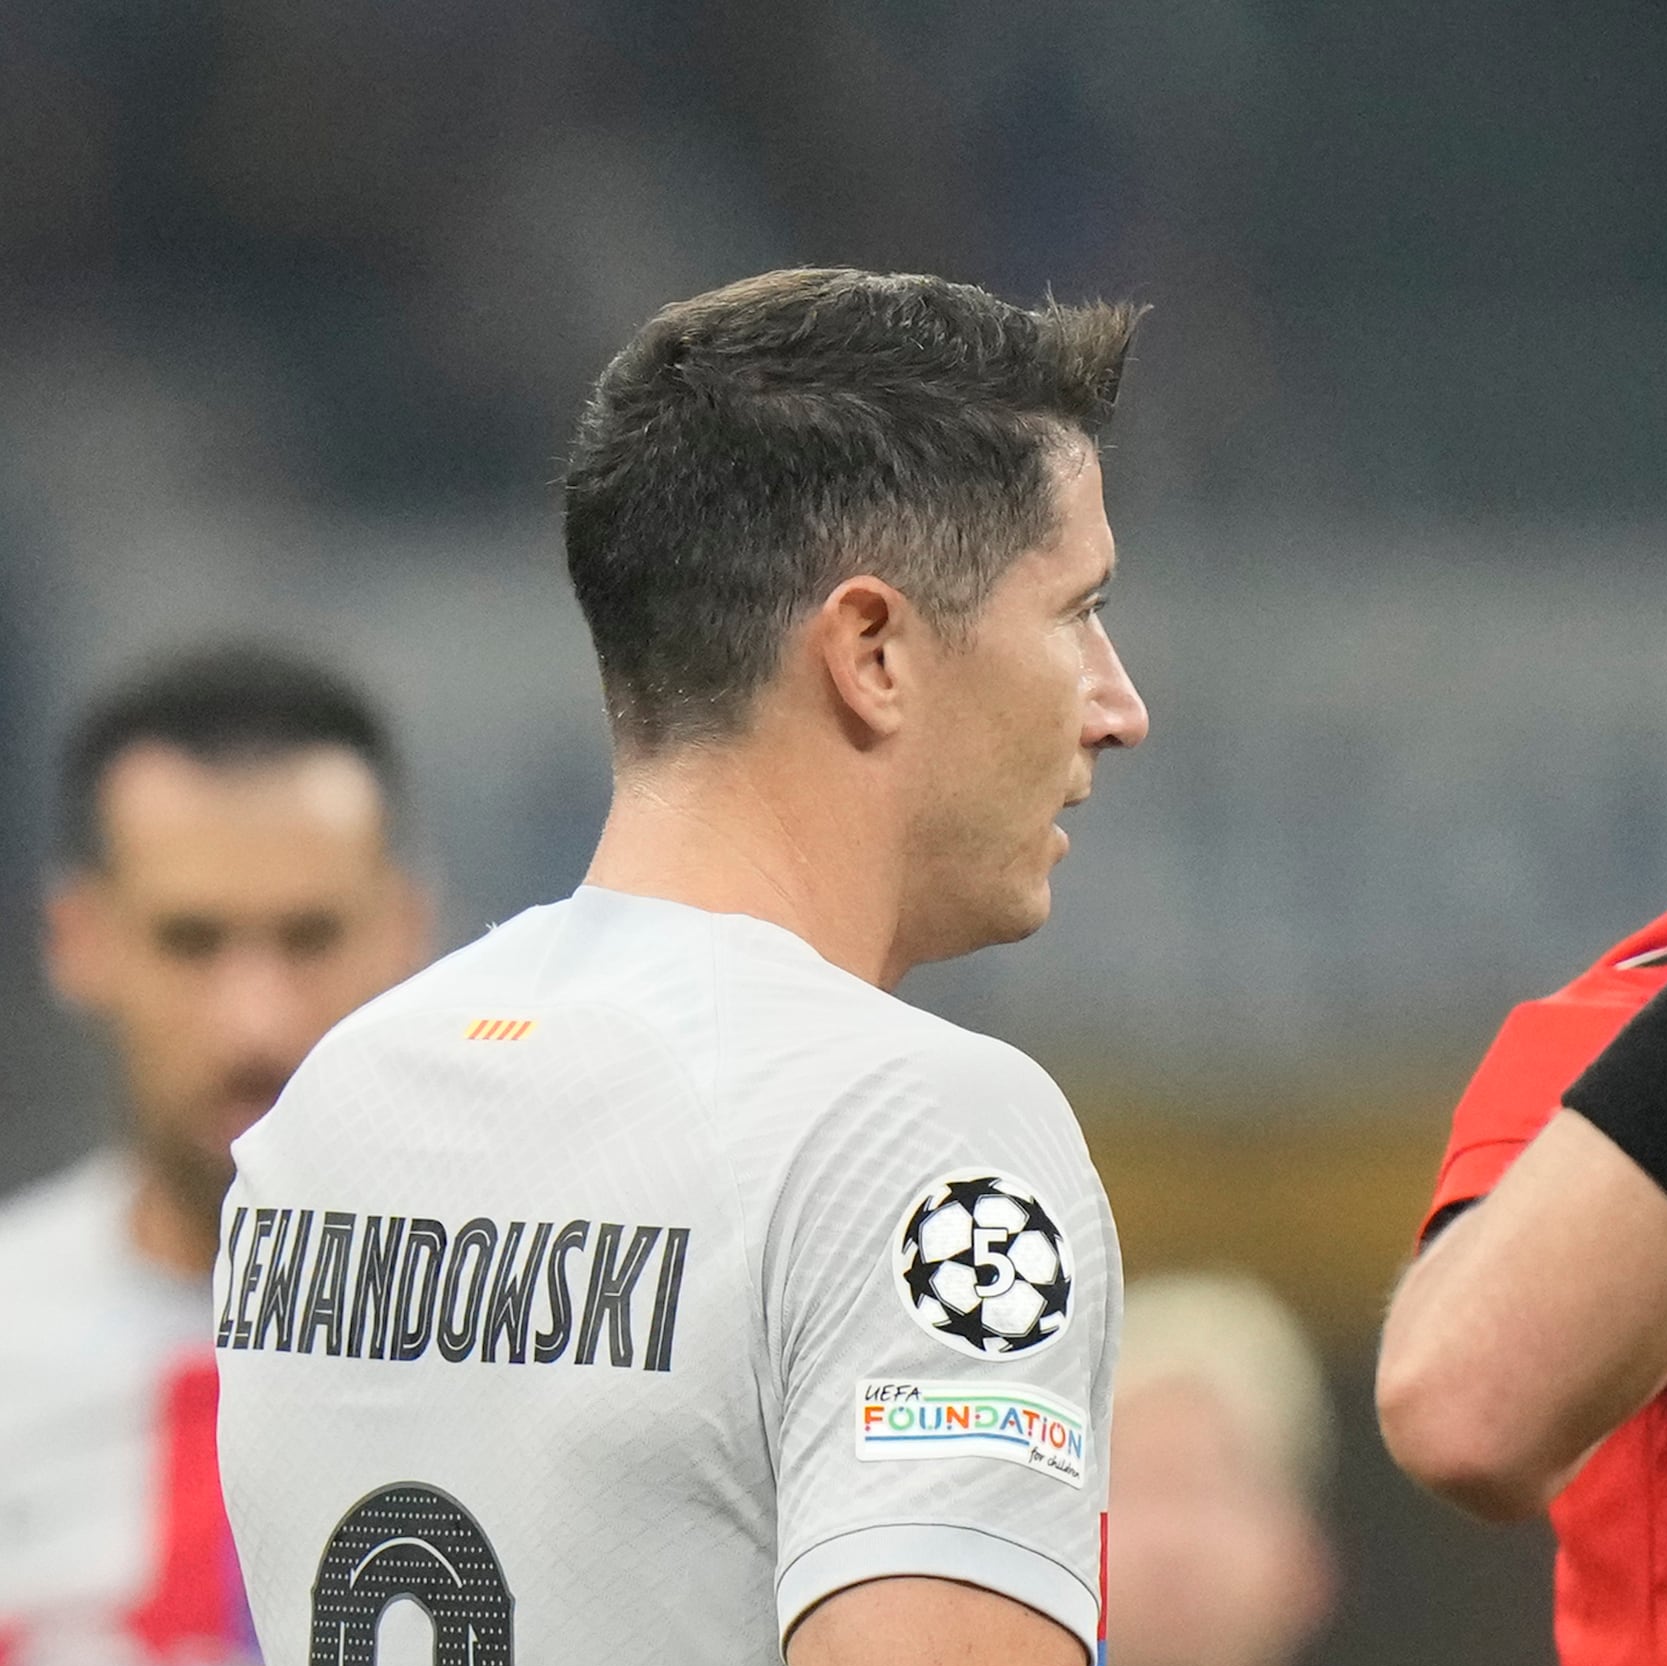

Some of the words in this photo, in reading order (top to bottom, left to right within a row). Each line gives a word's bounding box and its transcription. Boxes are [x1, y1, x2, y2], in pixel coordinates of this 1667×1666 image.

[215, 1206, 691, 1372] LEWANDOWSKI
[973, 1227, 1016, 1298] 5
[864, 1384, 921, 1402] UEFA
[864, 1405, 1082, 1459] FOUNDATION
[1028, 1446, 1045, 1464] for
[1047, 1455, 1081, 1480] children
